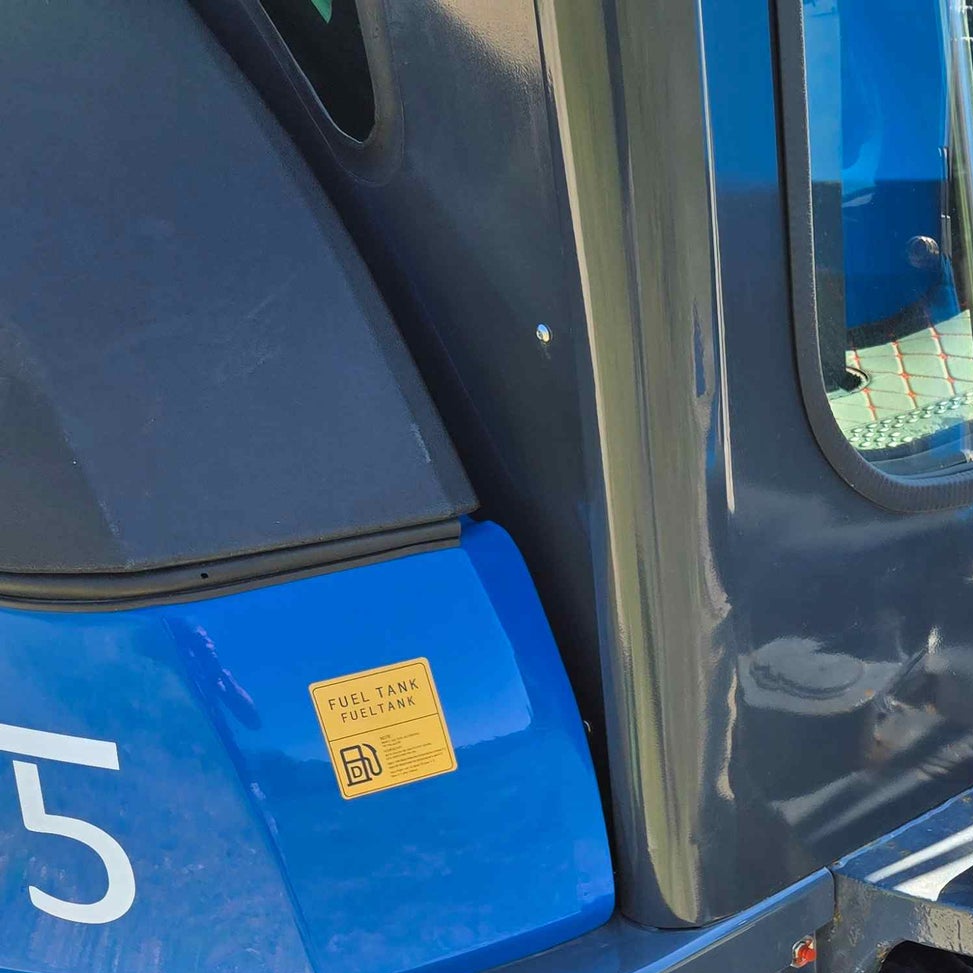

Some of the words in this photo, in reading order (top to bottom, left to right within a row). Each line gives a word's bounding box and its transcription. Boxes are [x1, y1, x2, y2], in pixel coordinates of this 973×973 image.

[328, 691, 370, 711] FUEL
[375, 678, 419, 699] TANK
[341, 696, 416, 724] FUELTANK
